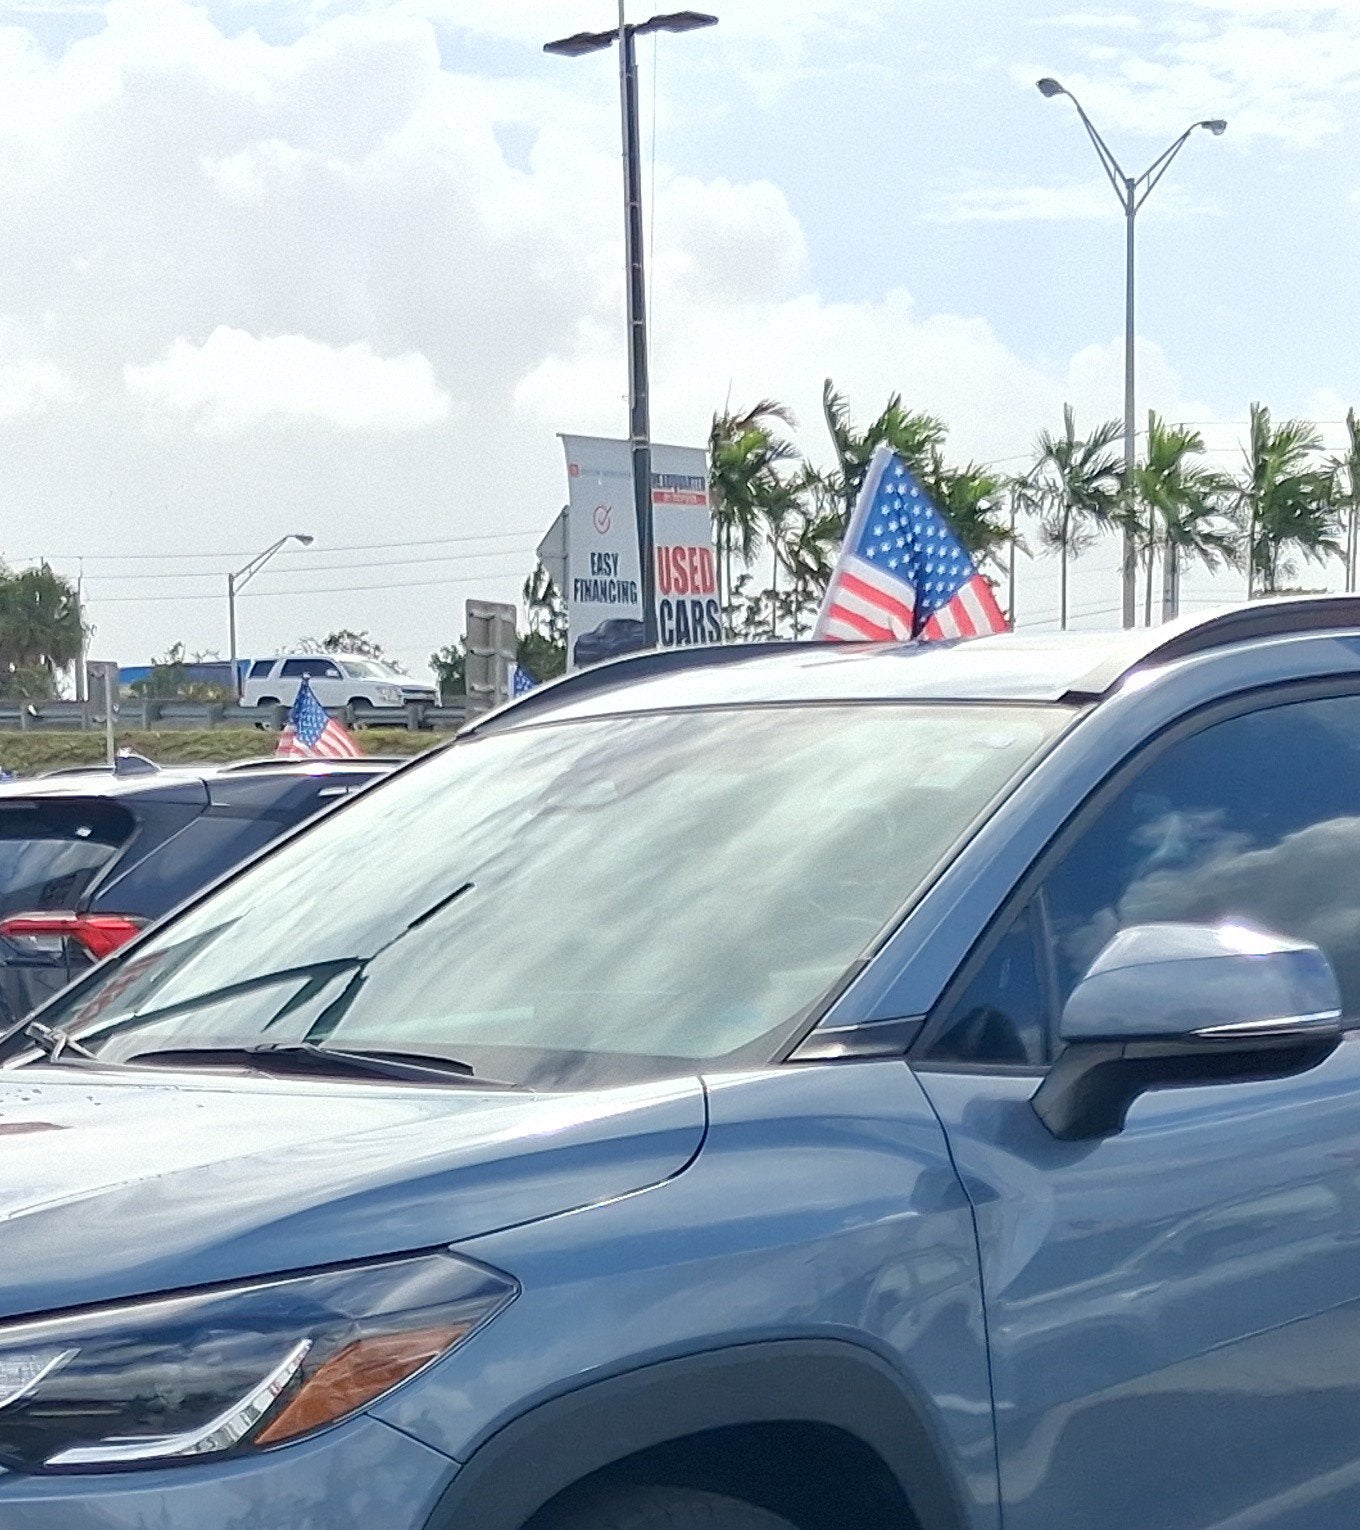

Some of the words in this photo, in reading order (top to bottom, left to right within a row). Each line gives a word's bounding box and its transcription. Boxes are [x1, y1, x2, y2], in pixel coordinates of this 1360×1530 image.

[590, 552, 619, 577] EASY
[657, 545, 716, 596] USED
[574, 578, 638, 605] FINANCING
[660, 599, 722, 646] CARS
